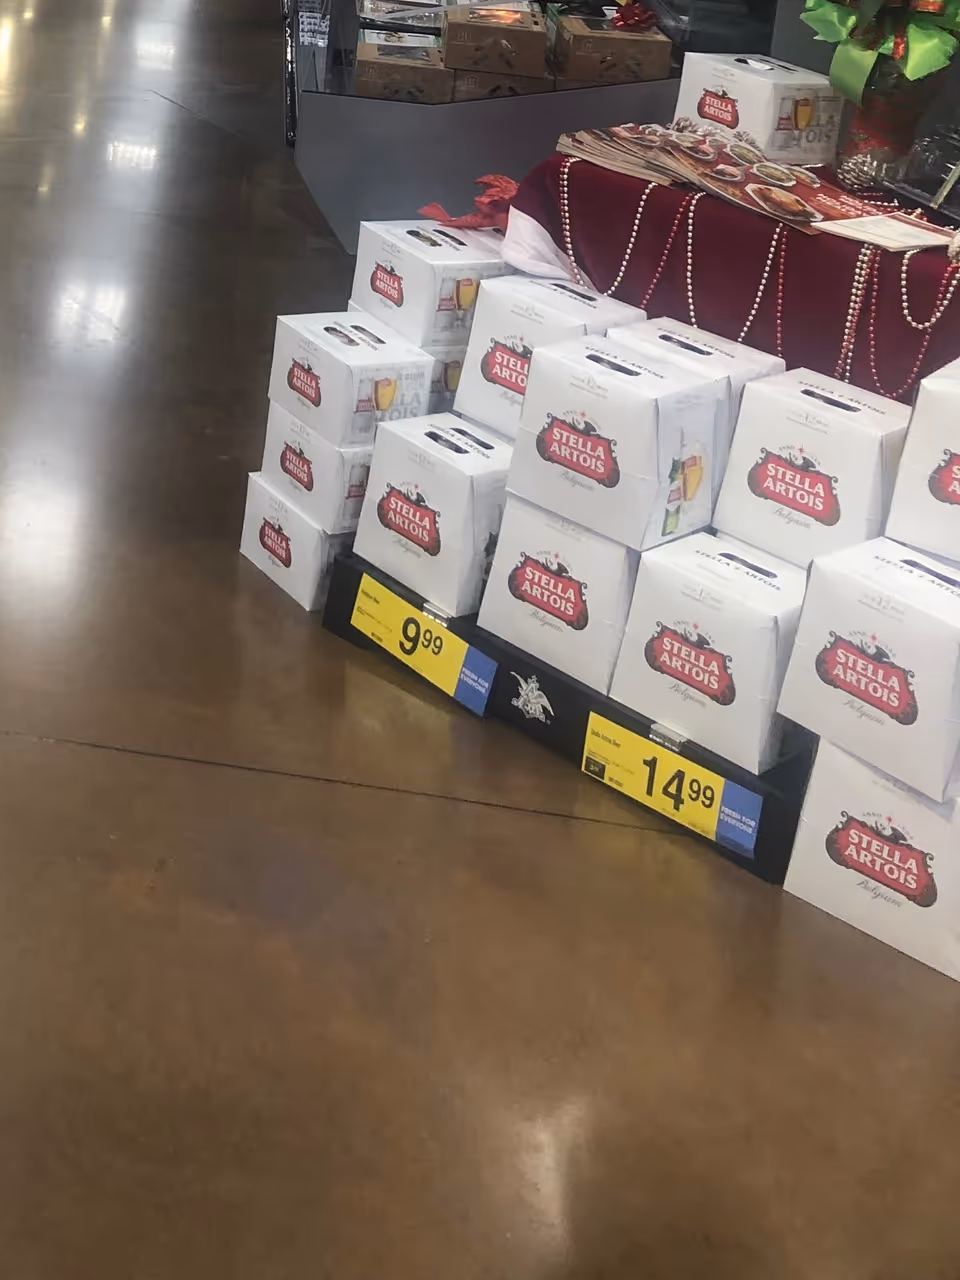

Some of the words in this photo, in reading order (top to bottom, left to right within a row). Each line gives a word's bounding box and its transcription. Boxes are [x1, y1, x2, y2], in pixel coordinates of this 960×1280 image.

[703, 105, 732, 121] ARTOIS
[705, 96, 733, 111] STELLA
[375, 281, 398, 299] ARTOIS
[377, 270, 399, 290] STELLA
[294, 368, 316, 388] STELLA
[492, 364, 527, 387] ARTO
[495, 351, 529, 375] STELL
[292, 378, 315, 397] ARTOIS
[550, 442, 605, 473] ARTOIS
[552, 428, 605, 460] STELLA
[285, 460, 308, 482] ARTOIS
[286, 450, 308, 473] STELLA
[763, 477, 824, 511] ARTOIS
[766, 463, 825, 498] STELLA
[388, 510, 429, 542] ARTOIS
[389, 497, 430, 530] STELLA
[263, 536, 286, 559] ARTOIS
[264, 524, 287, 548] STELLA
[521, 580, 574, 615] ARTOIS
[525, 566, 576, 603] STELLA
[660, 651, 719, 690] ARTOIS
[663, 637, 720, 675] STELLA
[836, 649, 901, 693] STELLA
[833, 664, 900, 708] ARTOIS
[844, 844, 917, 889] ARTOIS
[848, 828, 919, 875] STELLA
